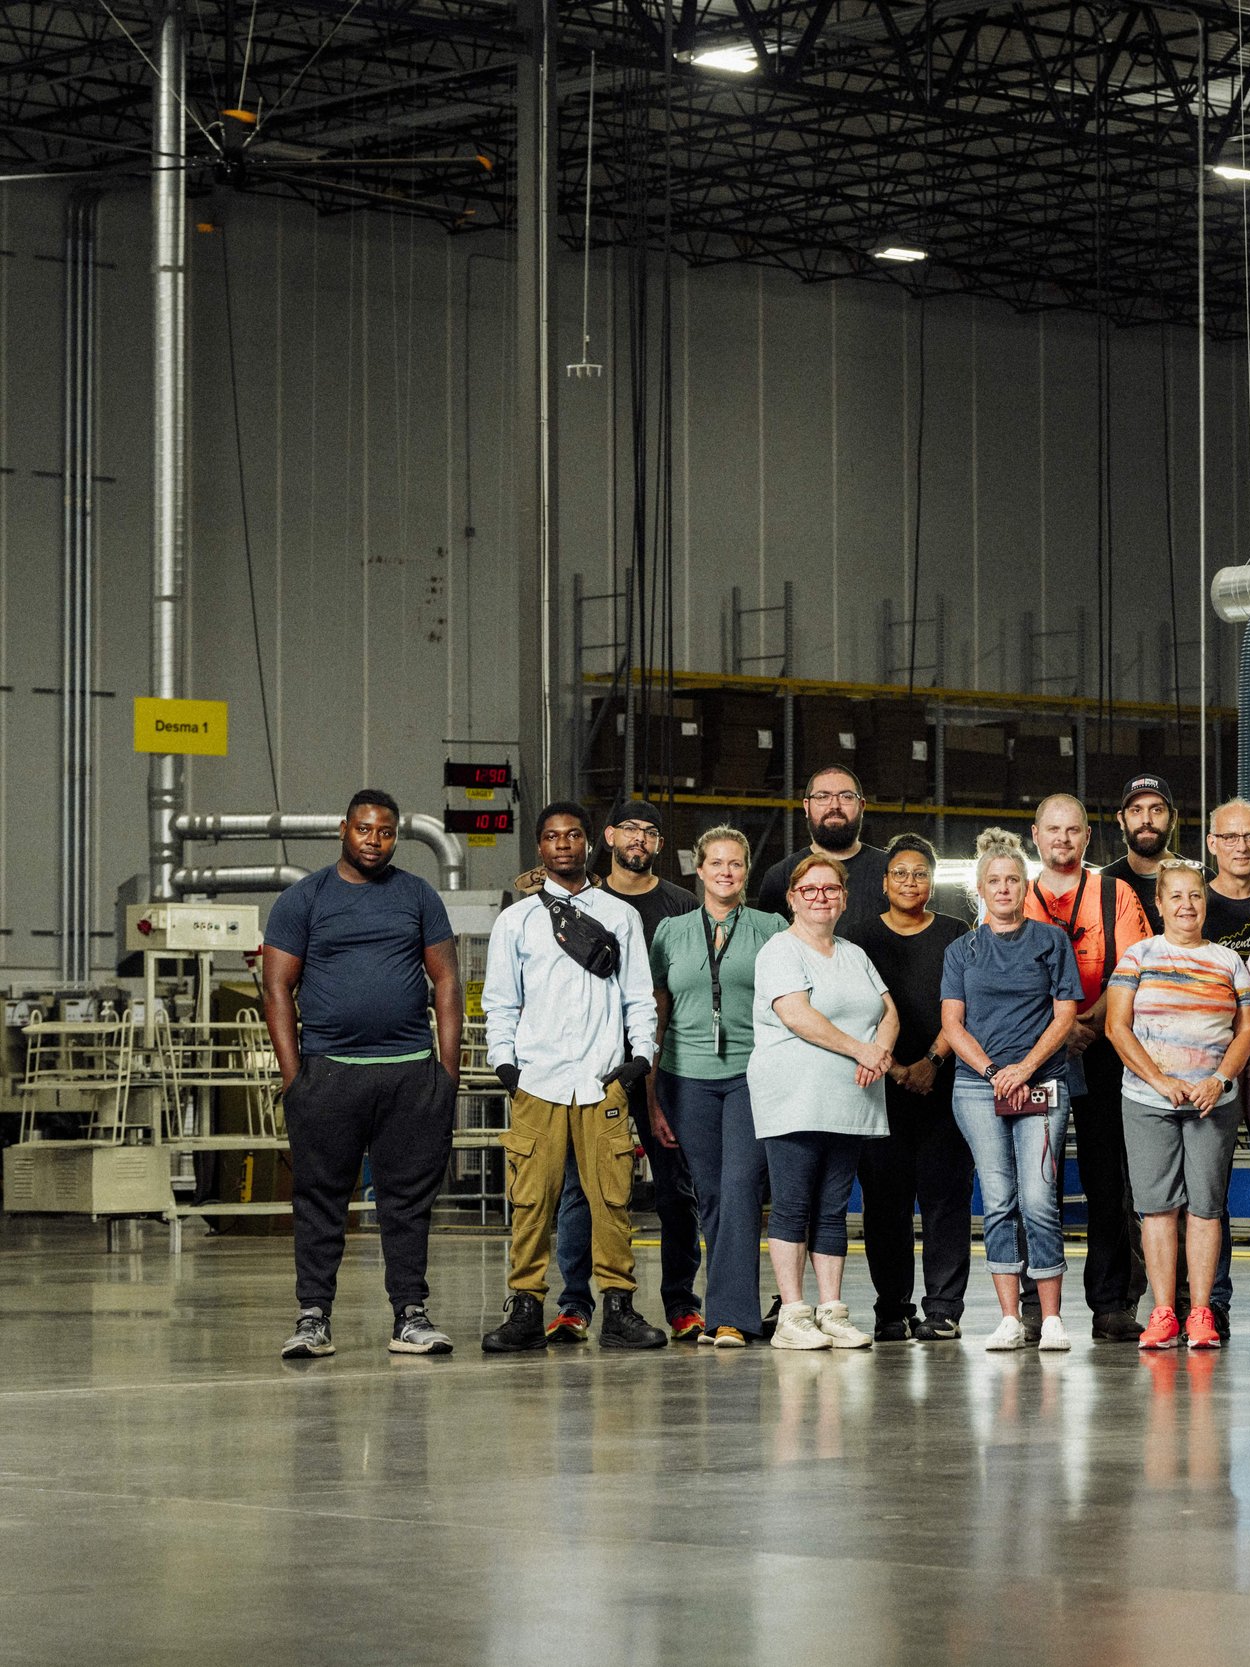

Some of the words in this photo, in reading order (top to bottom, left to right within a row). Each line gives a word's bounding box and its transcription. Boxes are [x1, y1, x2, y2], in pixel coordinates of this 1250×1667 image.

[155, 719, 199, 733] Desma
[202, 721, 209, 734] 1
[475, 814, 508, 829] 1010
